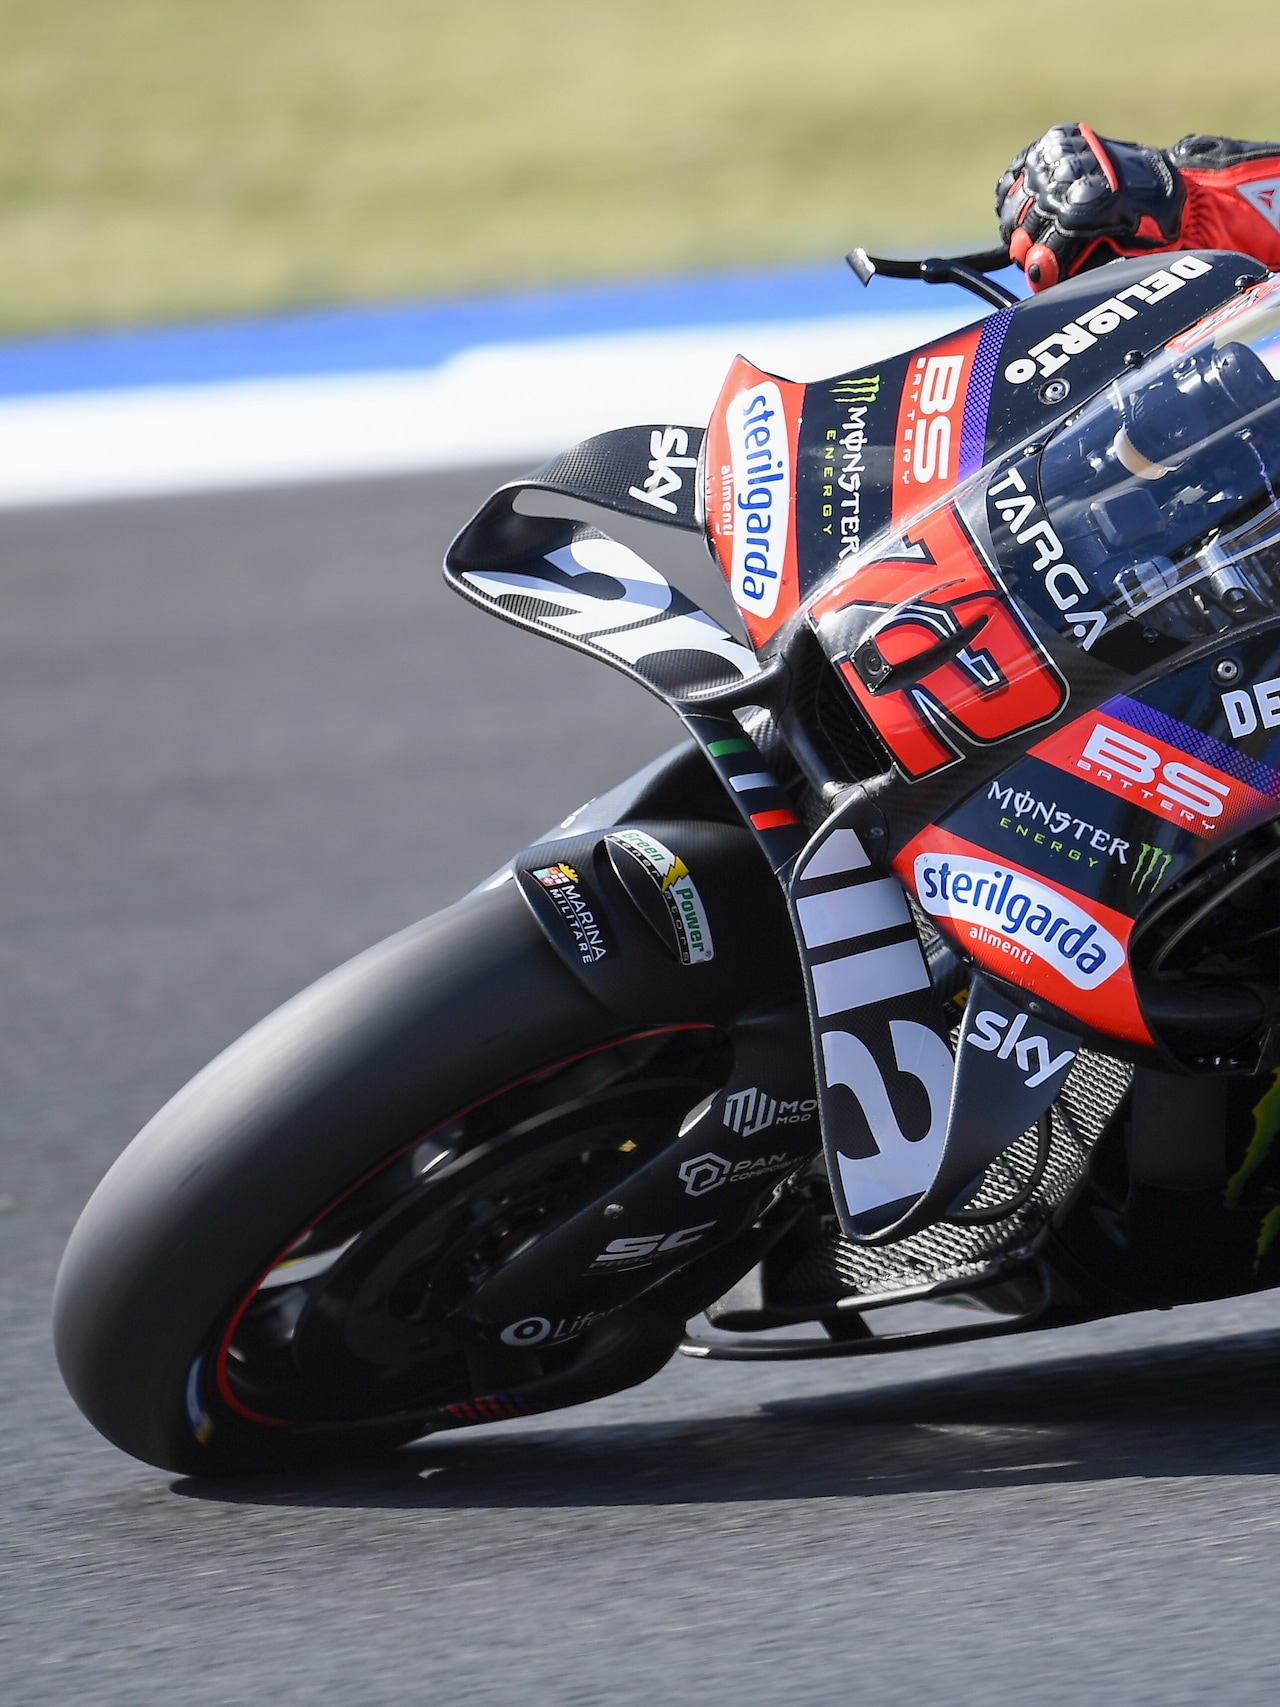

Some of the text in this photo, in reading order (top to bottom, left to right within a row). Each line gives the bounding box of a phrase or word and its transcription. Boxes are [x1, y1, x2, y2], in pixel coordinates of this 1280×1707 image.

[901, 357, 924, 485] BATTERY
[915, 354, 963, 484] BS
[628, 427, 698, 514] sky
[720, 464, 734, 536] alimenti
[738, 391, 787, 602] sterilgarda
[824, 428, 836, 536] ENERGY
[987, 467, 1107, 653] TARGA
[1077, 758, 1216, 832] BATTERY
[1083, 722, 1231, 819] BS
[986, 779, 1130, 866] MONSTER
[999, 815, 1100, 868] ENERGY
[548, 888, 594, 964] MILITARE
[560, 883, 608, 962] MARINA
[675, 886, 705, 953] Power
[920, 861, 1107, 976] sterilgarda
[967, 922, 1034, 966] alimenti
[965, 1009, 1076, 1089] sky
[733, 1151, 788, 1173] PAN
[596, 1219, 719, 1263] SC
